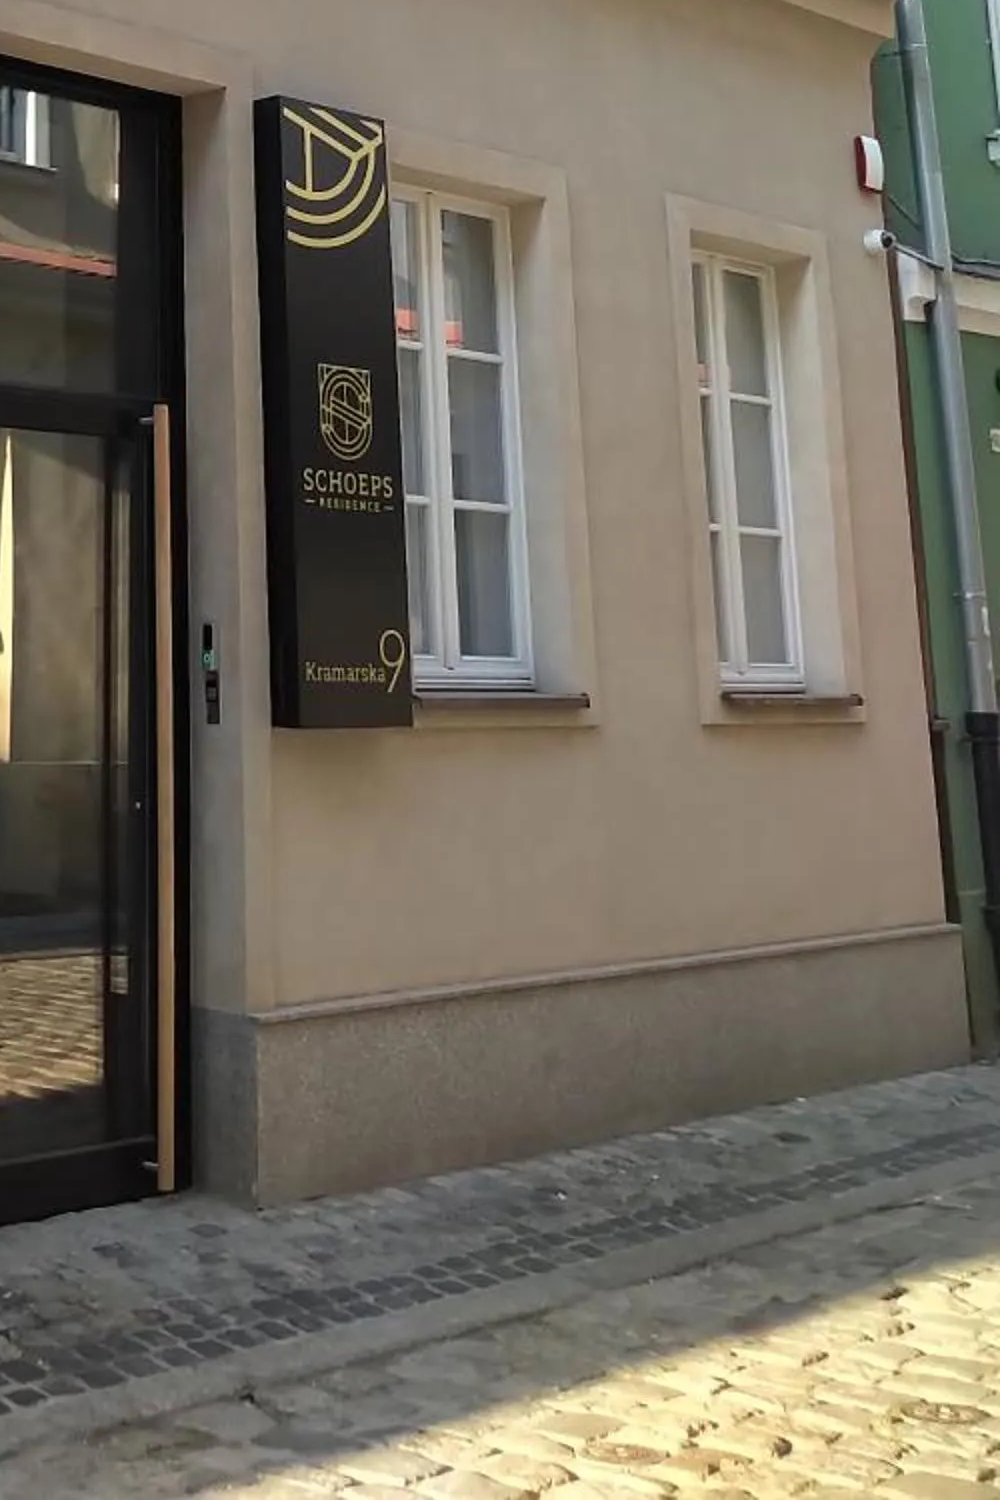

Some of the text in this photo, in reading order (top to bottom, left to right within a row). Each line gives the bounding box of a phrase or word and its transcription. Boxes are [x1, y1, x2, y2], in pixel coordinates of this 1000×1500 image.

[303, 467, 393, 499] SCHOEPS
[305, 629, 405, 693] Kramarska 9
